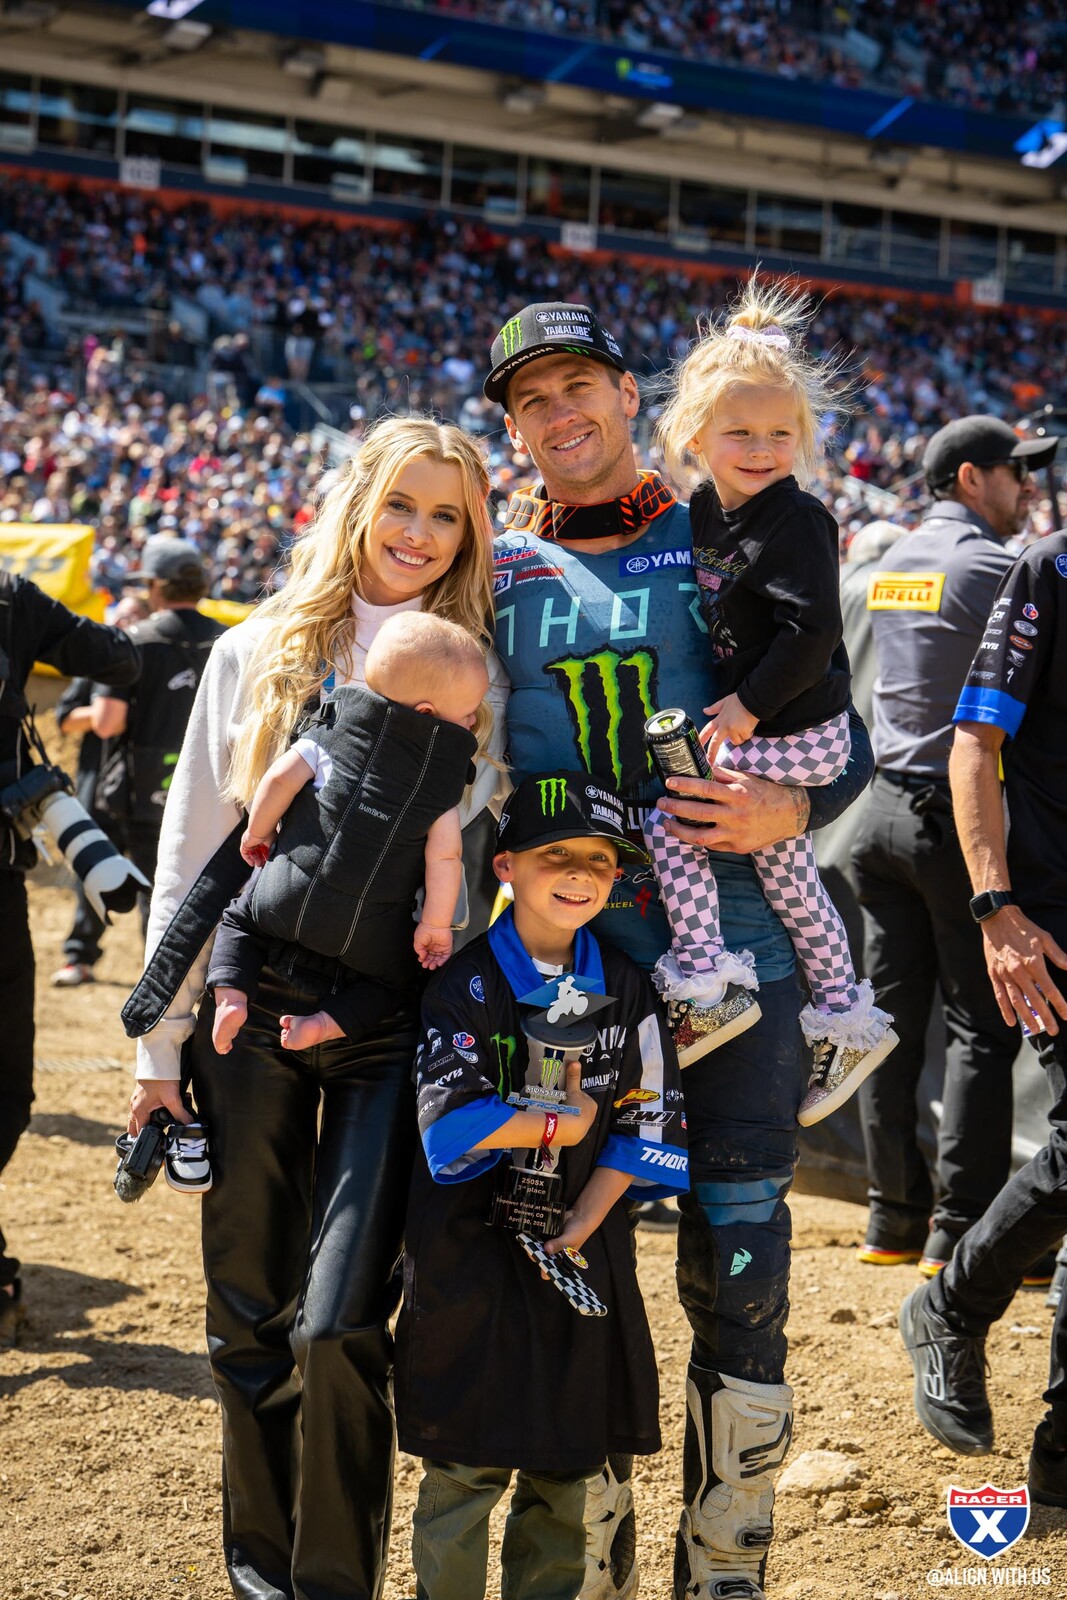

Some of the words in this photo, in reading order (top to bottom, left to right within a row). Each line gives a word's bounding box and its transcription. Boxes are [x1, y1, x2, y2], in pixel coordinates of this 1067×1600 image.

[549, 311, 591, 324] YAMAHA
[504, 346, 555, 371] YAMAHA
[872, 580, 934, 602] PIRELLI
[603, 901, 634, 910] EXCEL
[434, 1067, 464, 1087] KYB
[526, 1085, 566, 1100] MONSTER
[508, 1096, 581, 1115] SUPERCROSS
[640, 1146, 688, 1171] THOR
[521, 1177, 545, 1187] 250SX
[526, 1187, 546, 1195] place
